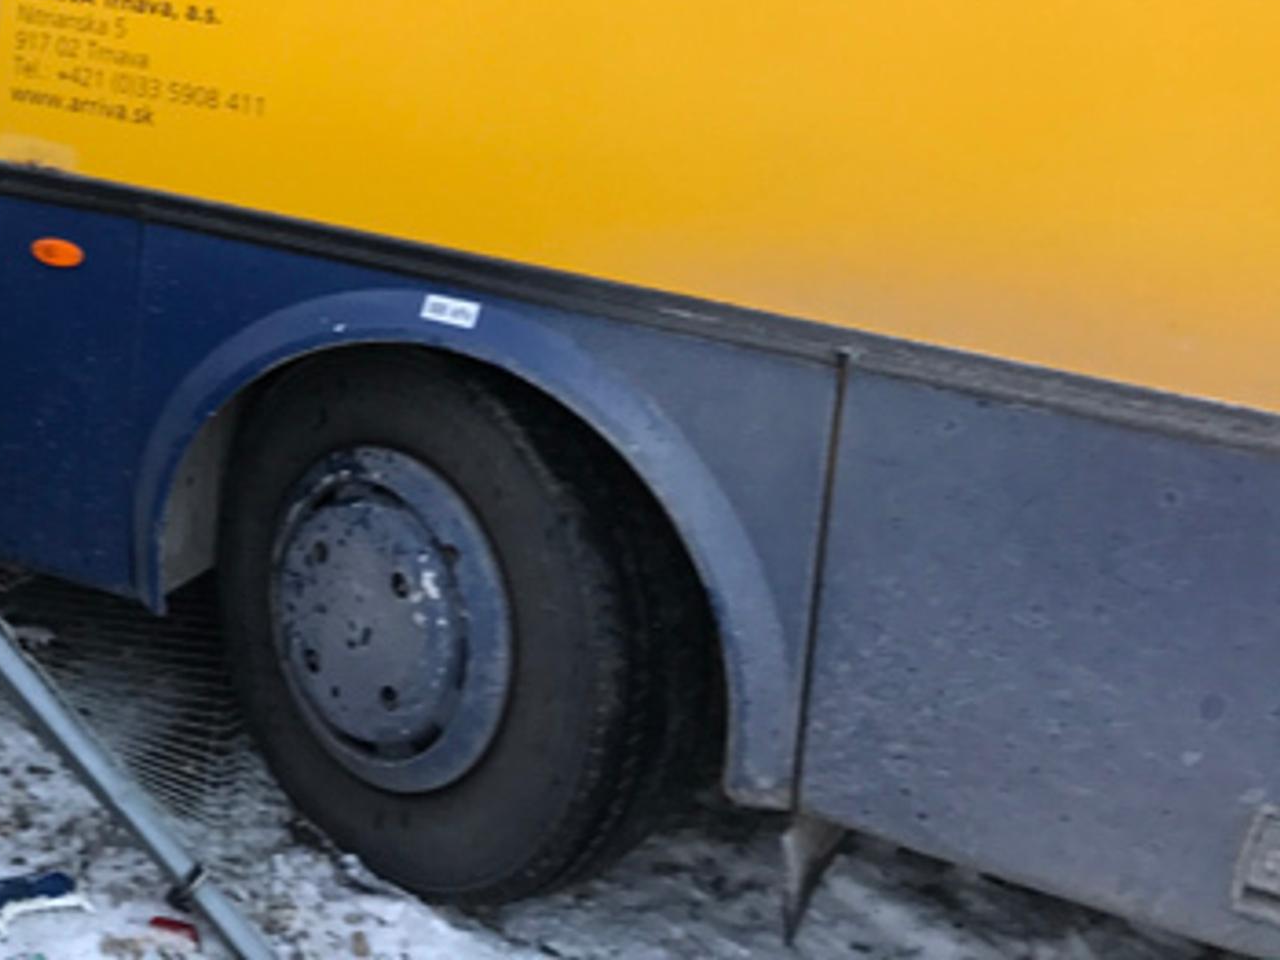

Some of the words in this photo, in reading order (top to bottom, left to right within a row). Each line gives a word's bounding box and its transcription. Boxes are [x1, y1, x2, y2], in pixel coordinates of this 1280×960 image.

[114, 17, 127, 38] 5
[185, 5, 222, 24] a.s.
[14, 30, 51, 52] 917
[55, 36, 80, 58] 02
[87, 40, 150, 69] Trnava
[11, 87, 154, 125] www.arriva.sk
[57, 67, 104, 88] +421
[167, 82, 219, 109] 5908
[225, 93, 265, 117] 411
